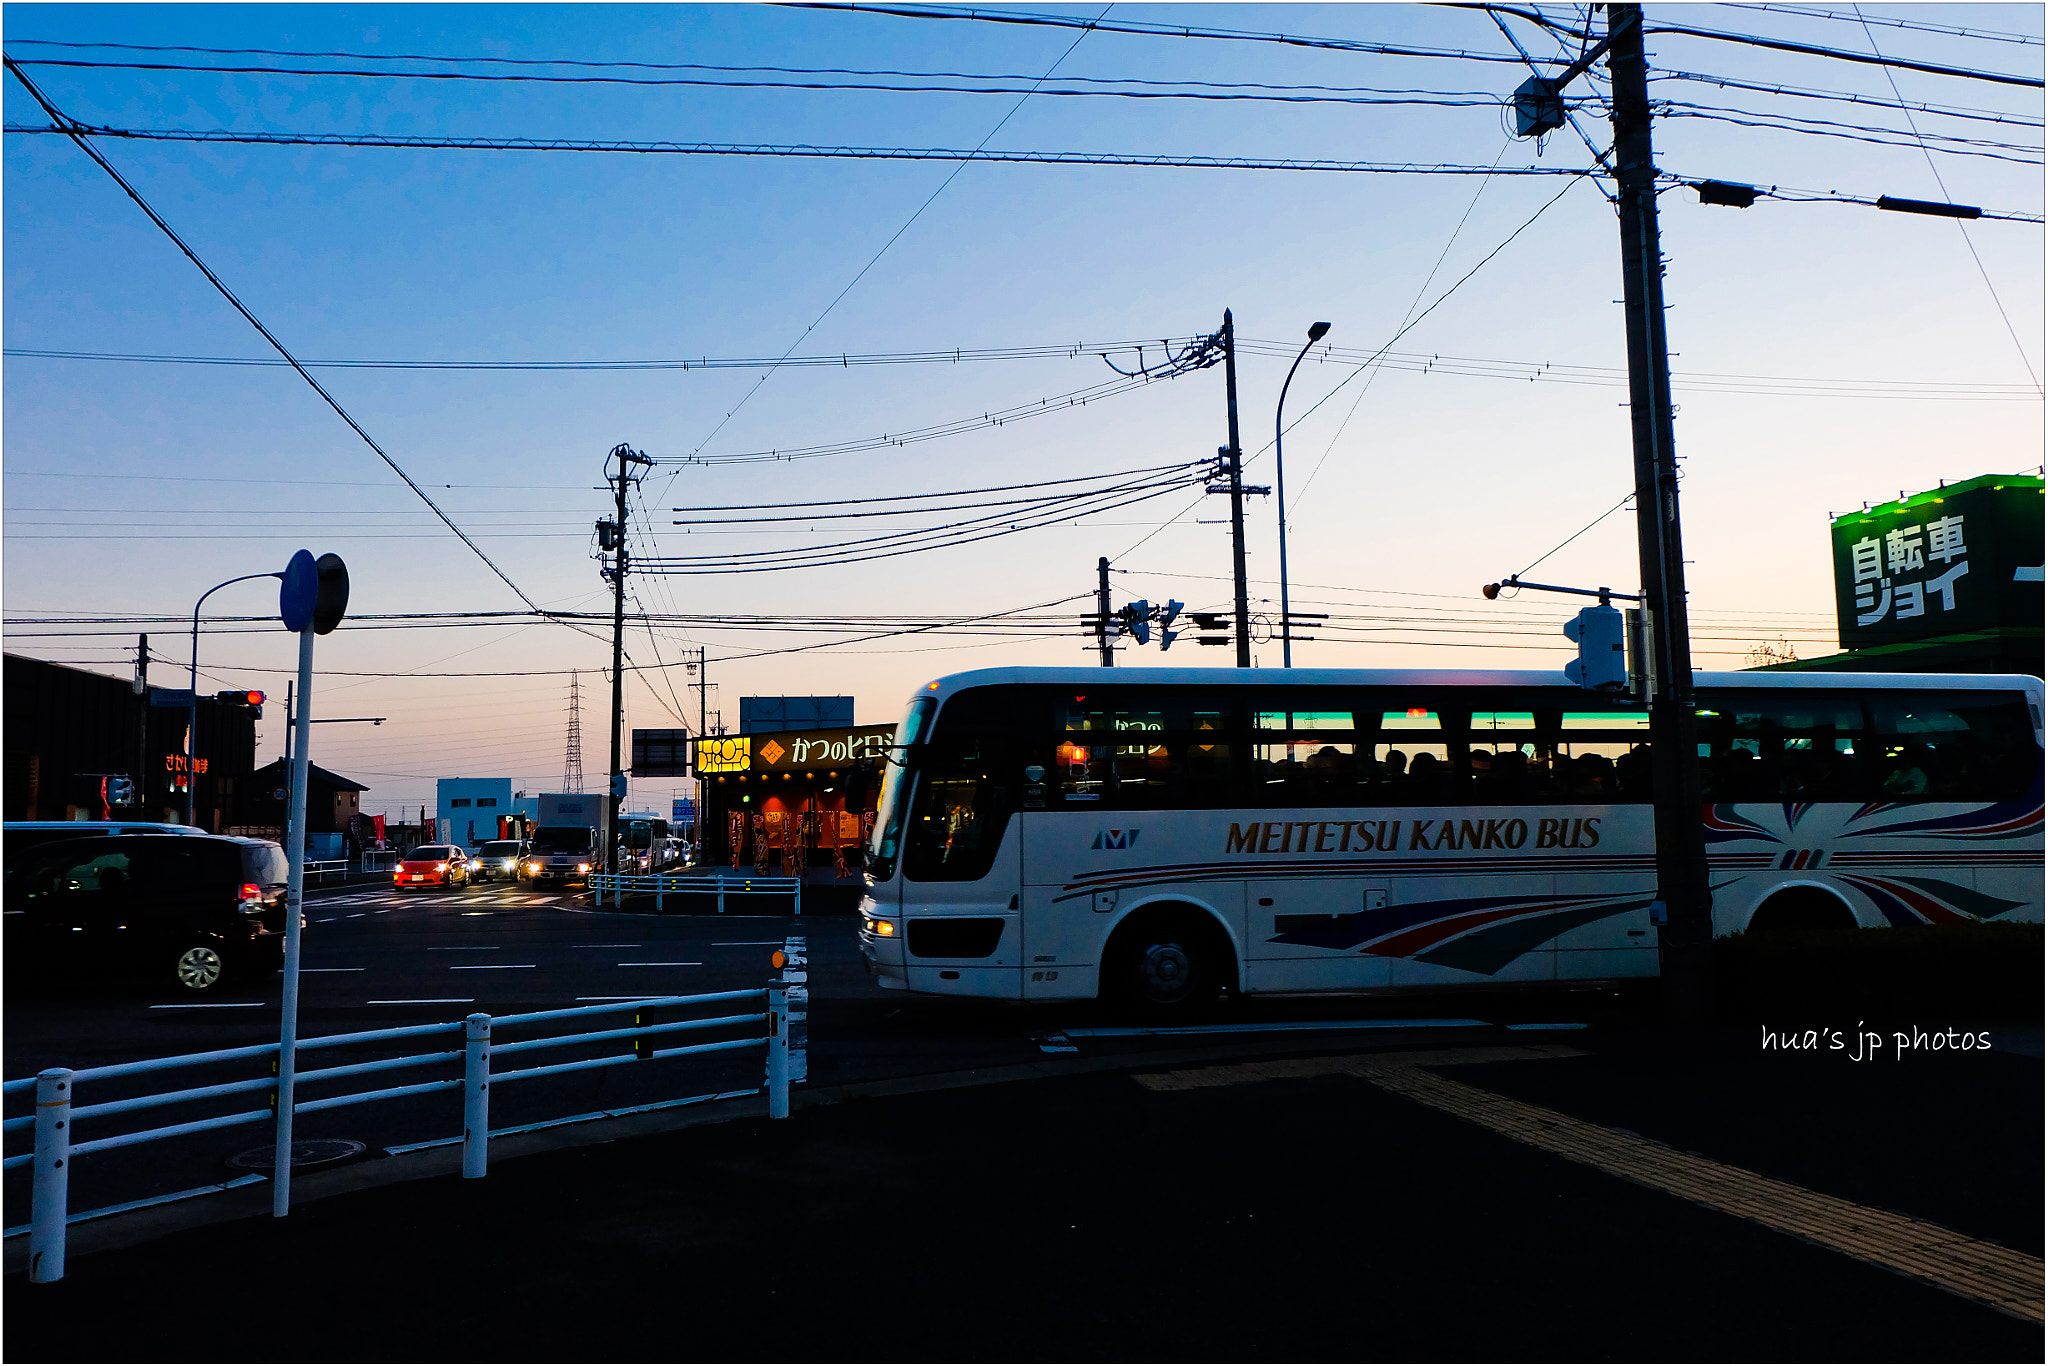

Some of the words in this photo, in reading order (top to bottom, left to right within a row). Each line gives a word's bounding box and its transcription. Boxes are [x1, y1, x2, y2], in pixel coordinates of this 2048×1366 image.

[1851, 514, 1967, 584] 自転車
[1855, 560, 1970, 627] ジョイ
[1225, 820, 1402, 854] MEITETSU
[1409, 818, 1528, 851] KANKO
[1536, 817, 1602, 850] BUS
